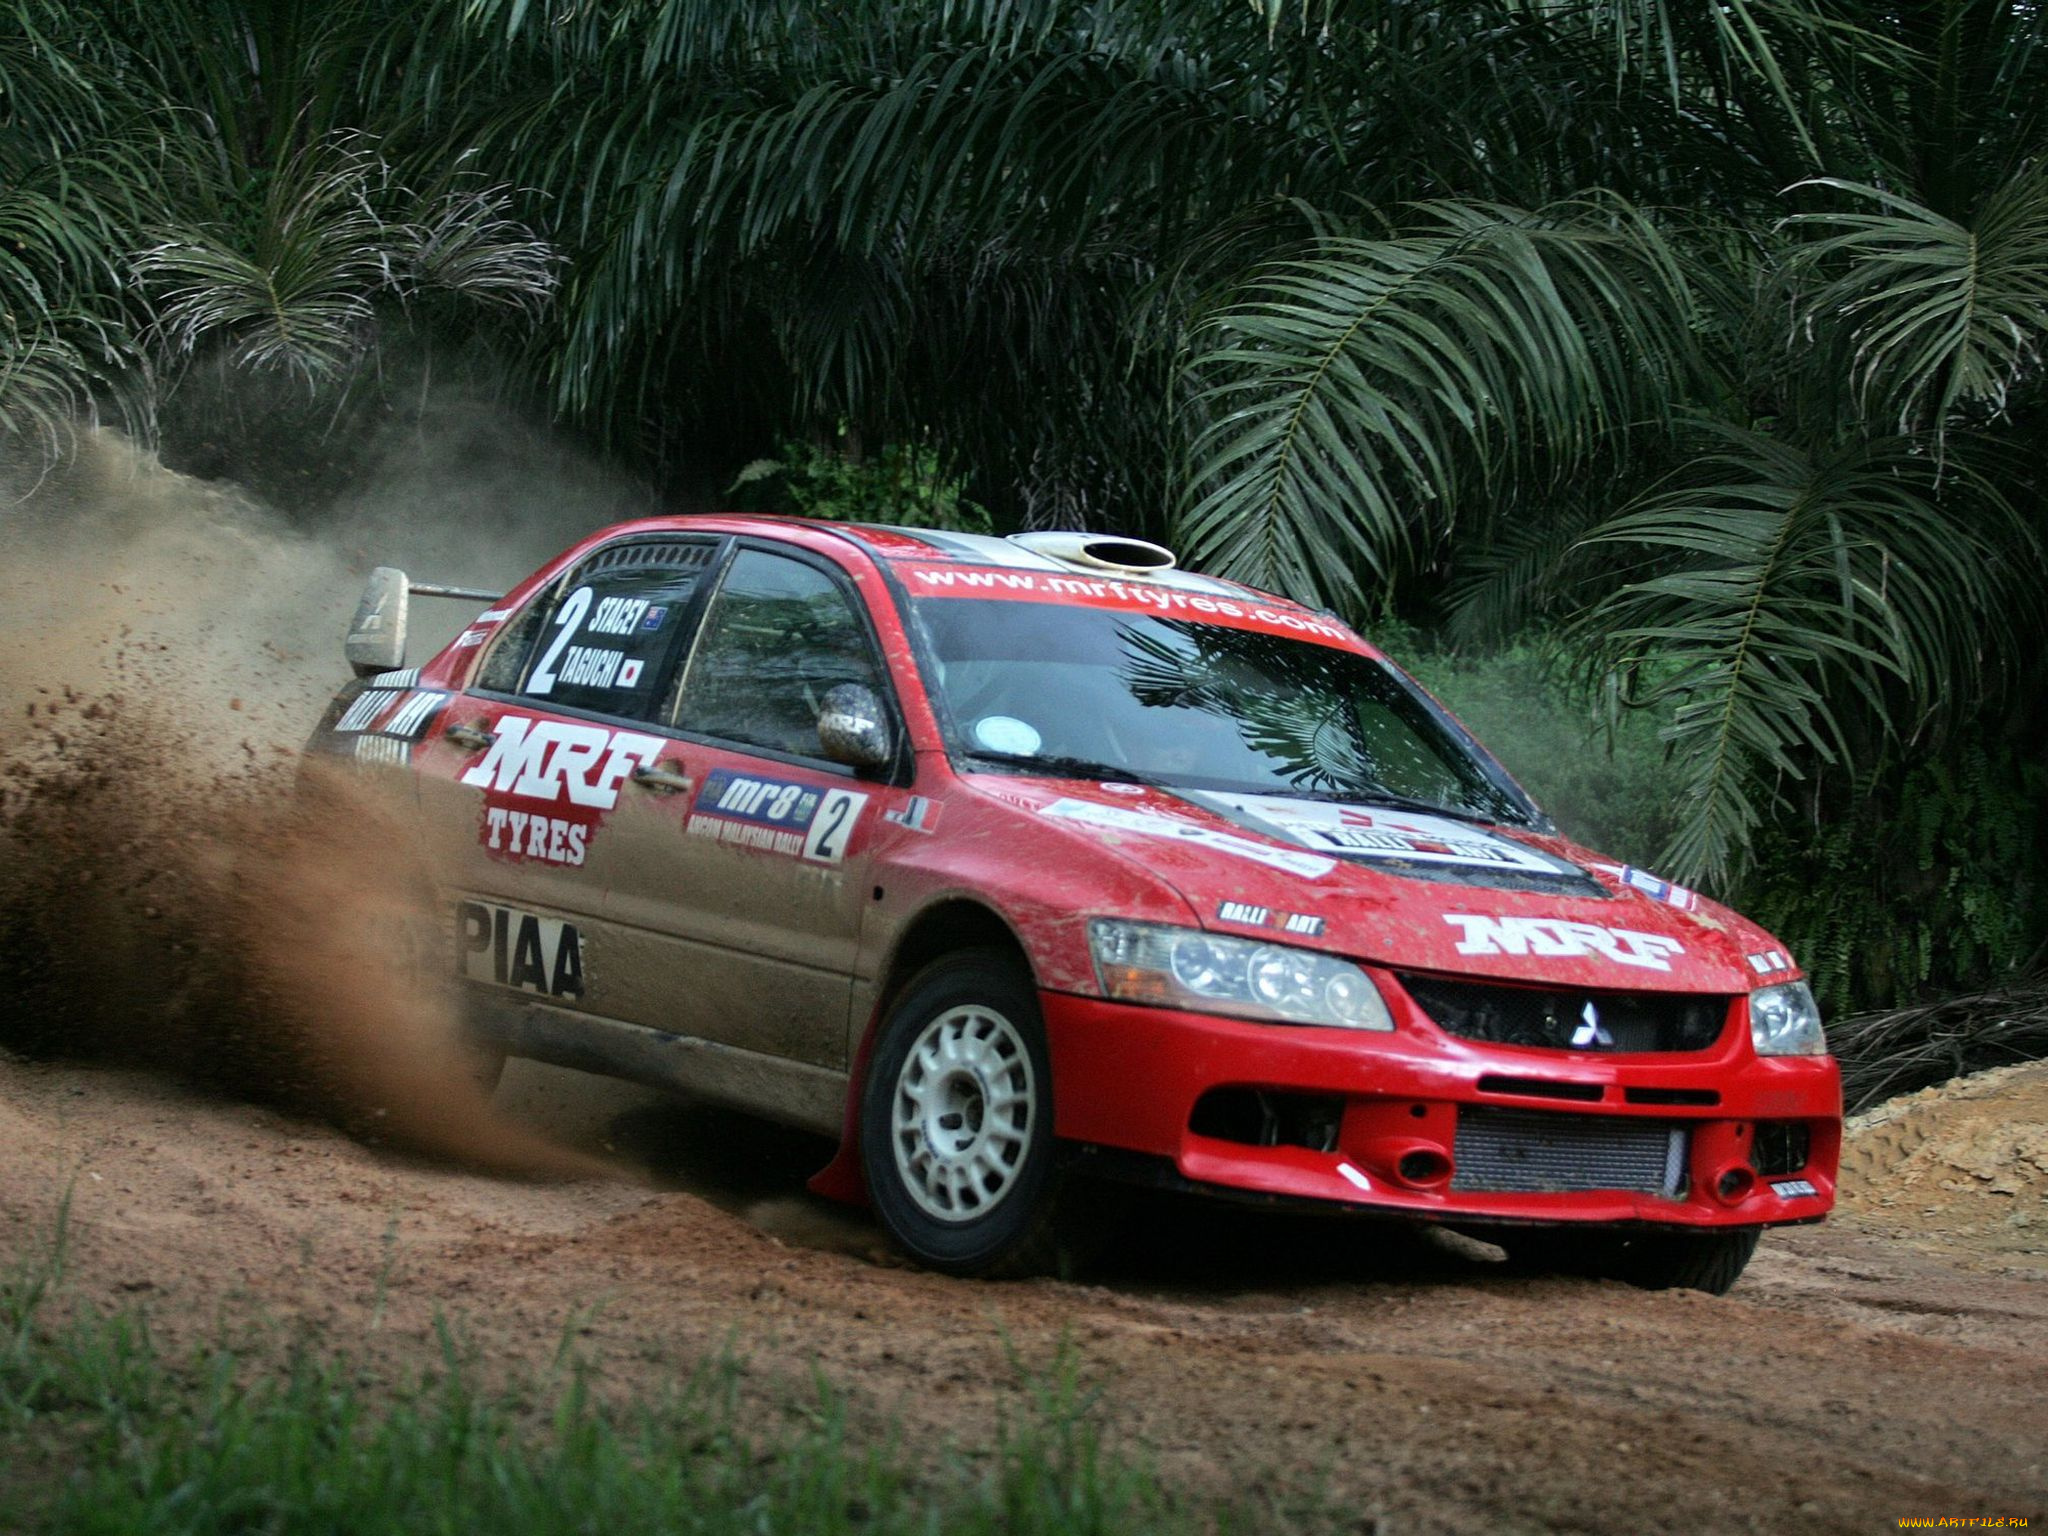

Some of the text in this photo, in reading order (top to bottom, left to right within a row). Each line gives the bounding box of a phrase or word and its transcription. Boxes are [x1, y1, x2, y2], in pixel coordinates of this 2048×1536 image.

[588, 596, 650, 636] STACEY
[913, 568, 1346, 642] www.mrftyres.com
[525, 586, 593, 694] 2
[557, 645, 625, 679] TAGUCHI
[460, 715, 667, 810] MRF
[717, 778, 803, 820] mr8
[814, 796, 852, 857] 2
[487, 807, 588, 866] TYRES
[773, 831, 805, 856] RALLY
[456, 901, 586, 998] PIAA
[1285, 913, 1321, 935] ART
[1442, 913, 1685, 972] MRF
